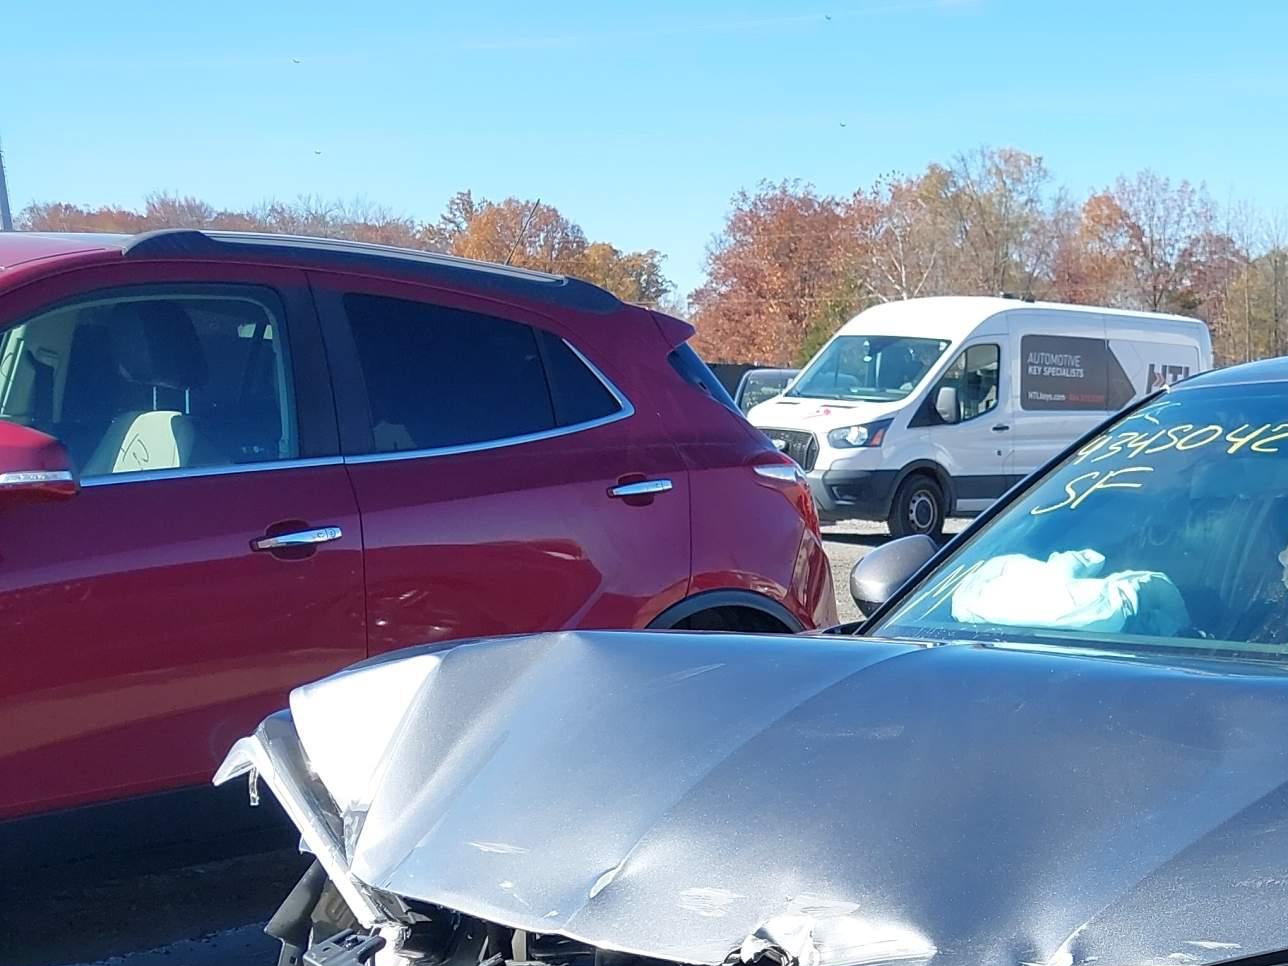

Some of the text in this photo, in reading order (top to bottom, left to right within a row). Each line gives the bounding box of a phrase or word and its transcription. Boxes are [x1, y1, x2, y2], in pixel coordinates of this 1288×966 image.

[1027, 352, 1081, 366] AUTOMOTIVE
[1028, 366, 1084, 378] KEY SPECIALISTS
[1030, 467, 1154, 516] SF
